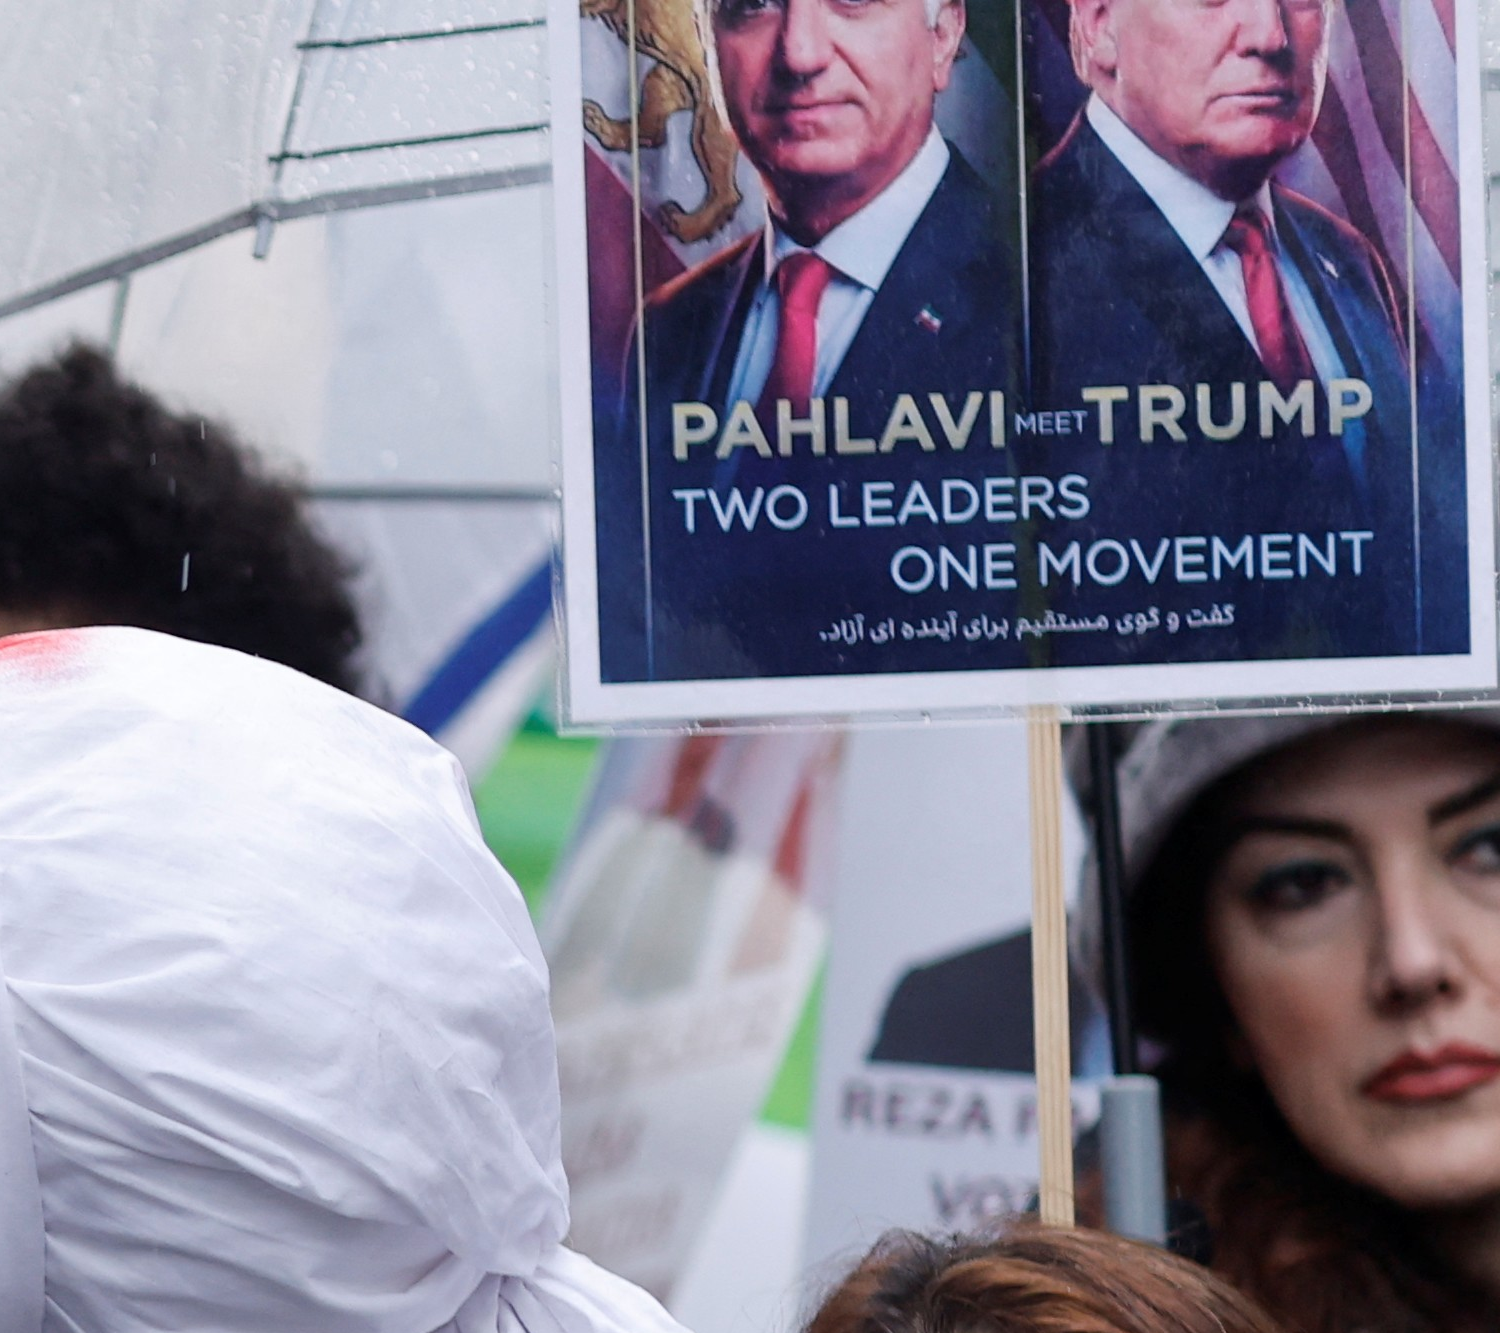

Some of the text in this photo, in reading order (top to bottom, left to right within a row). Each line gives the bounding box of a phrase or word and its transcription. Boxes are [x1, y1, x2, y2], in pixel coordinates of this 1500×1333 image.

[672, 378, 1374, 462] PAHLAVI MEET TRUMP
[672, 473, 1091, 536] TWO LEADERS
[889, 531, 1374, 593] ONE MOVEMENT
[900, 610, 958, 641] آینده
[962, 612, 1009, 642] برای
[1016, 609, 1109, 641] مستقیم
[1116, 607, 1160, 635] گوی
[1166, 612, 1180, 635] و
[1187, 603, 1236, 627] گفت
[870, 617, 894, 645] ای
[841, 1080, 992, 1135] REZA
